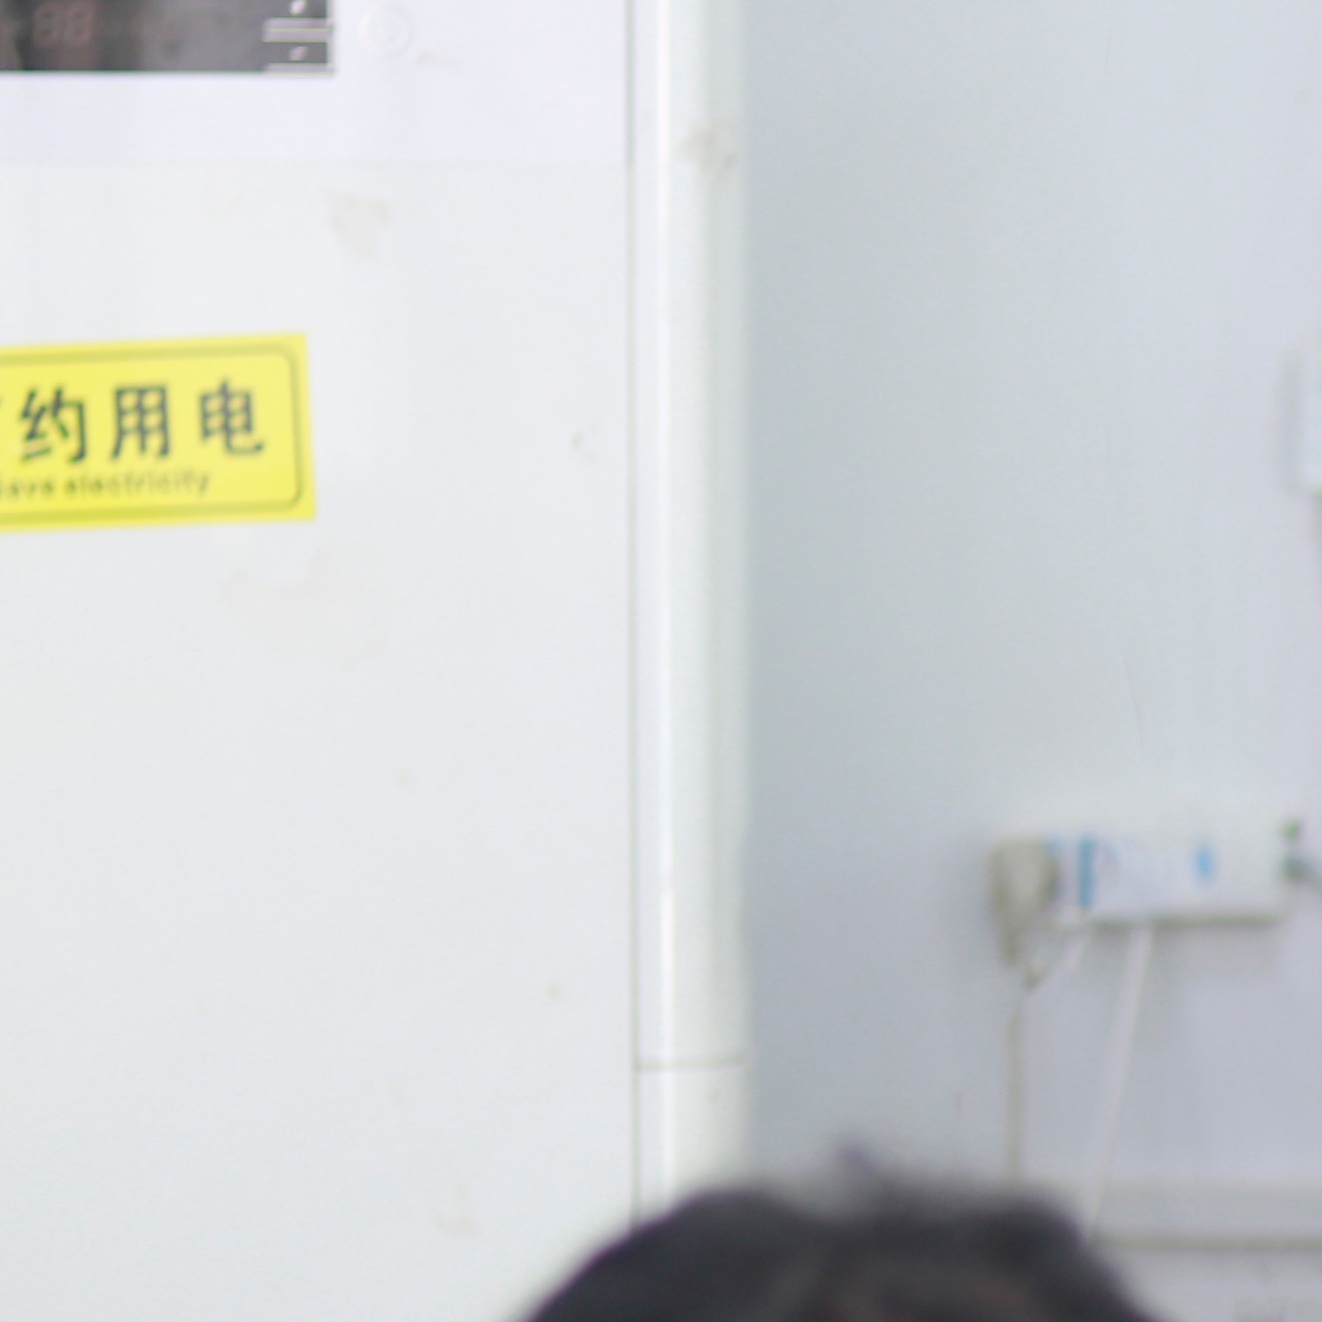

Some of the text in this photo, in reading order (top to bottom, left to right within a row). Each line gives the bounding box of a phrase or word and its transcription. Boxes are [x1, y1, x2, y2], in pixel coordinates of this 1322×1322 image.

[0, 375, 266, 464] 约用电
[64, 467, 211, 498] electricity
